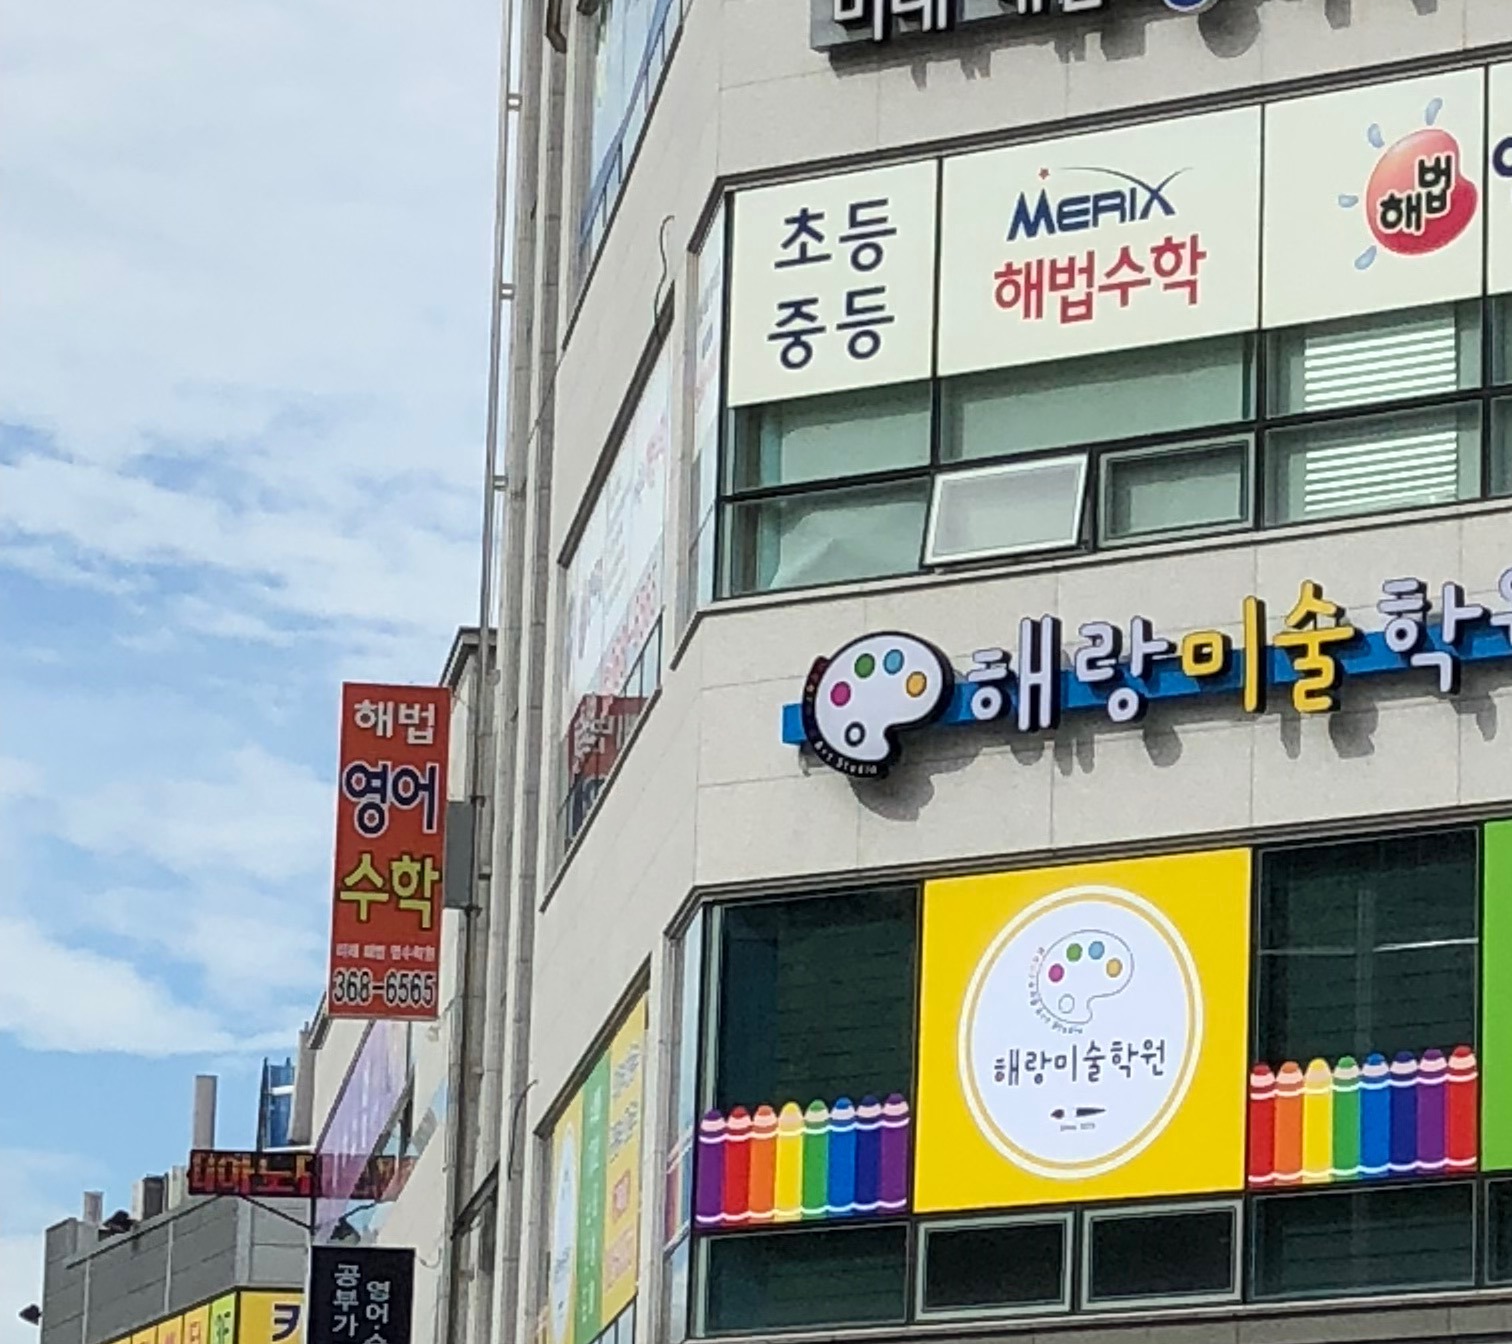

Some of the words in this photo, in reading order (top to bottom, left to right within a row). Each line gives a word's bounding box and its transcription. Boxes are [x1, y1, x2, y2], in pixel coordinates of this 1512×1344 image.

[1377, 154, 1453, 233] 해법
[774, 198, 897, 273] 초등
[994, 234, 1207, 325] 해법수학
[768, 286, 895, 370] 중등
[354, 698, 435, 745] 해법
[343, 761, 439, 838] 영어
[340, 853, 440, 929] 수학
[333, 968, 435, 1005] 368-6565
[993, 1039, 1166, 1086] 해랑미술학원
[332, 1263, 361, 1338] 공부가
